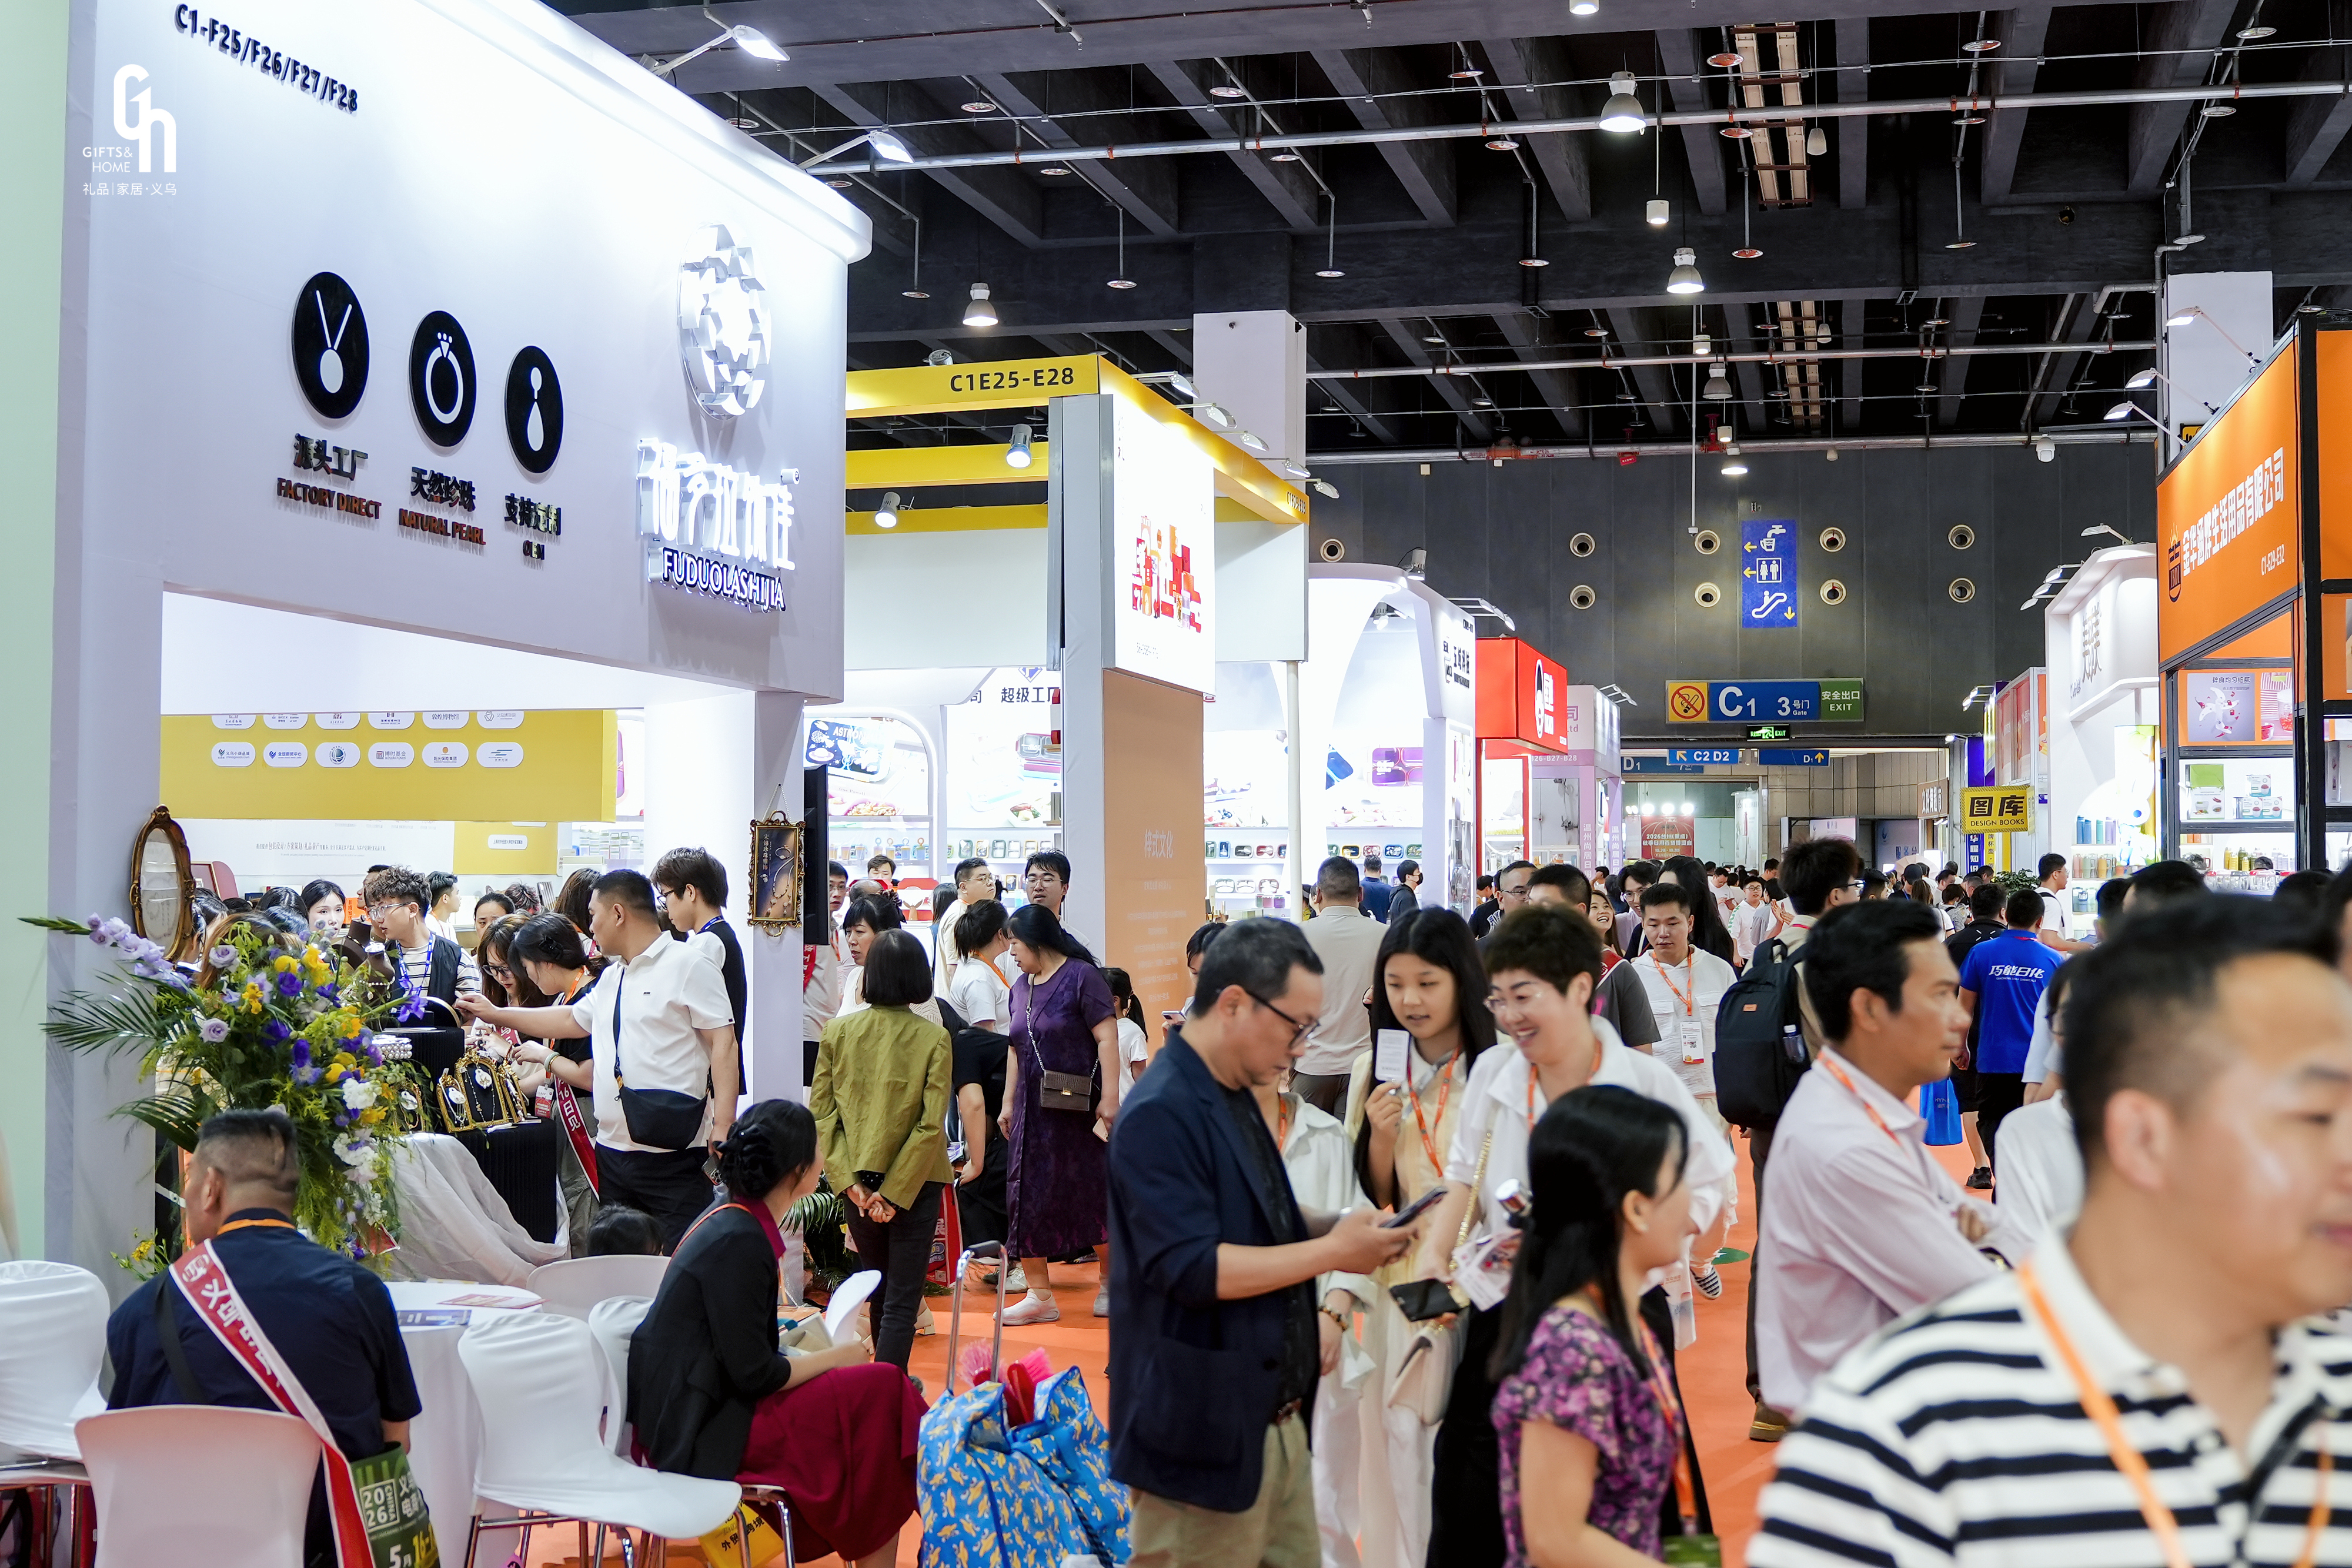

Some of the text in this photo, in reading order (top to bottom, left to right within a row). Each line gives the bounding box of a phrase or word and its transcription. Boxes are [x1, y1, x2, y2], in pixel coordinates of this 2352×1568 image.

[175, 4, 358, 114] C1-F25/F26/F27/F28
[950, 367, 1074, 392] C1E25-E28
[293, 433, 369, 481] 源头工厂
[277, 477, 382, 520] FACTORY DIRECT
[410, 466, 476, 512] 天然珍珠
[399, 508, 486, 546] NATURAL PEARL
[504, 493, 562, 536] 支持定制
[2261, 544, 2285, 576] C1-E29-E32
[662, 547, 786, 612] FUDUOLASHIJIA
[1001, 687, 1060, 703] 超级工厂
[1719, 686, 1809, 717] C1 3 号门
[1822, 690, 1860, 700] 安全出口
[1623, 757, 1641, 771] D1
[1693, 751, 1729, 761] C2 D2
[1804, 755, 1813, 763] D1
[1969, 795, 2025, 817] 图库
[1989, 965, 2045, 979] 巧能日化
[363, 1487, 385, 1509] 20
[385, 1485, 396, 1521] CHINA
[366, 1505, 388, 1527] 26
